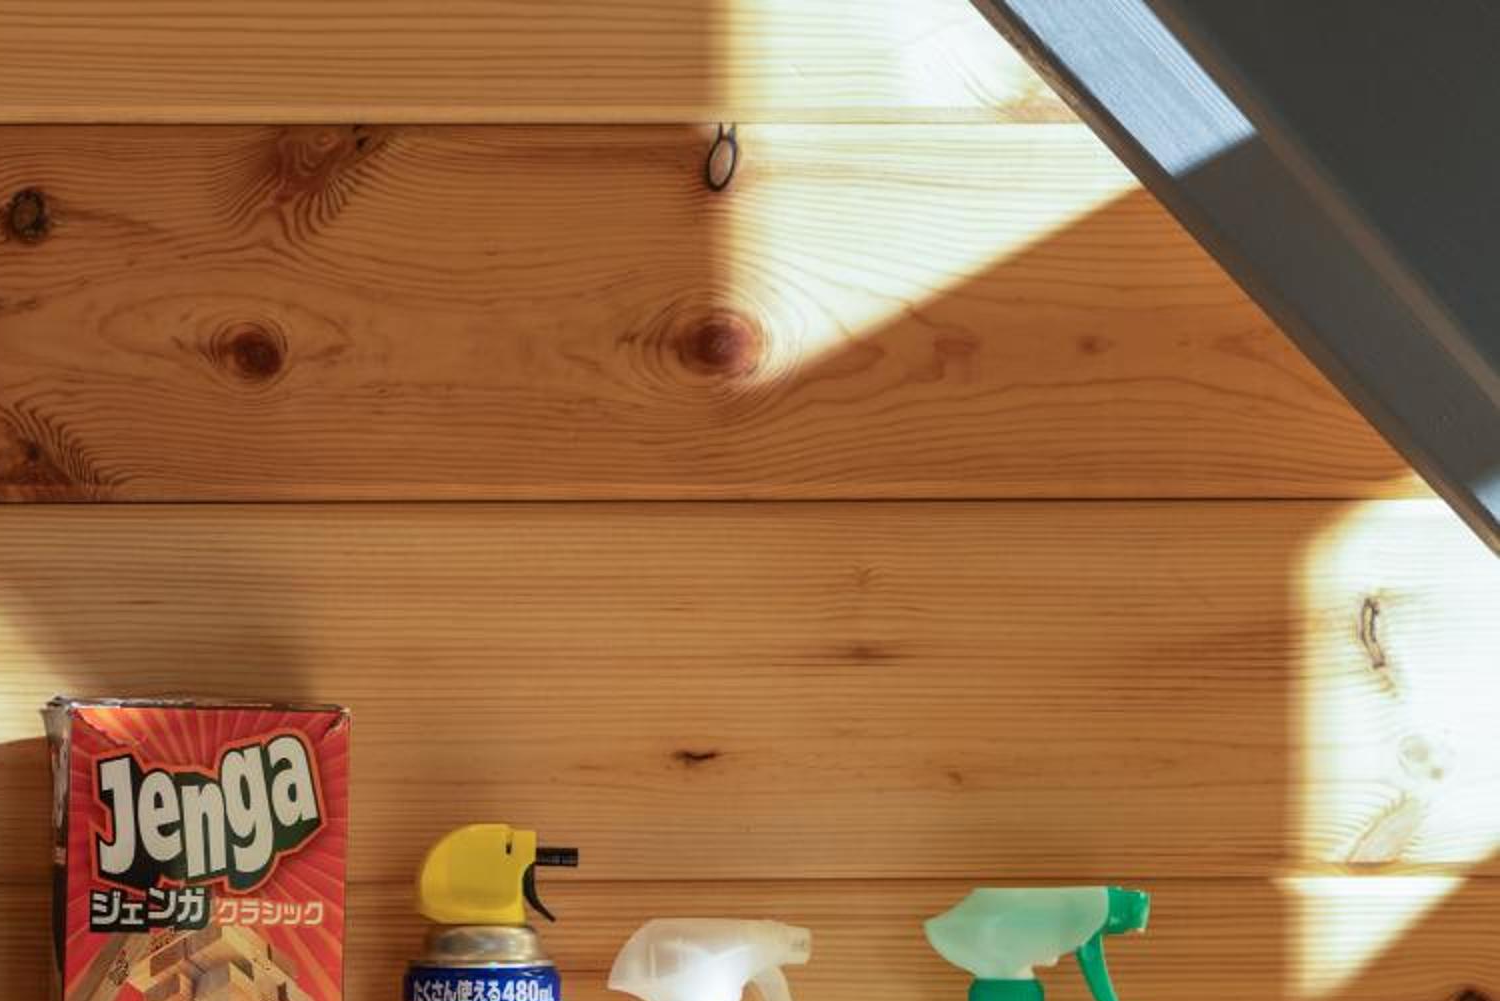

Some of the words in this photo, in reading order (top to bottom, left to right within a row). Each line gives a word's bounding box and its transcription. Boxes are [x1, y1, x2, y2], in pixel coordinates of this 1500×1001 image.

[99, 736, 320, 877] Jenga
[90, 887, 206, 926] ジェンガ
[218, 900, 324, 925] クラシック
